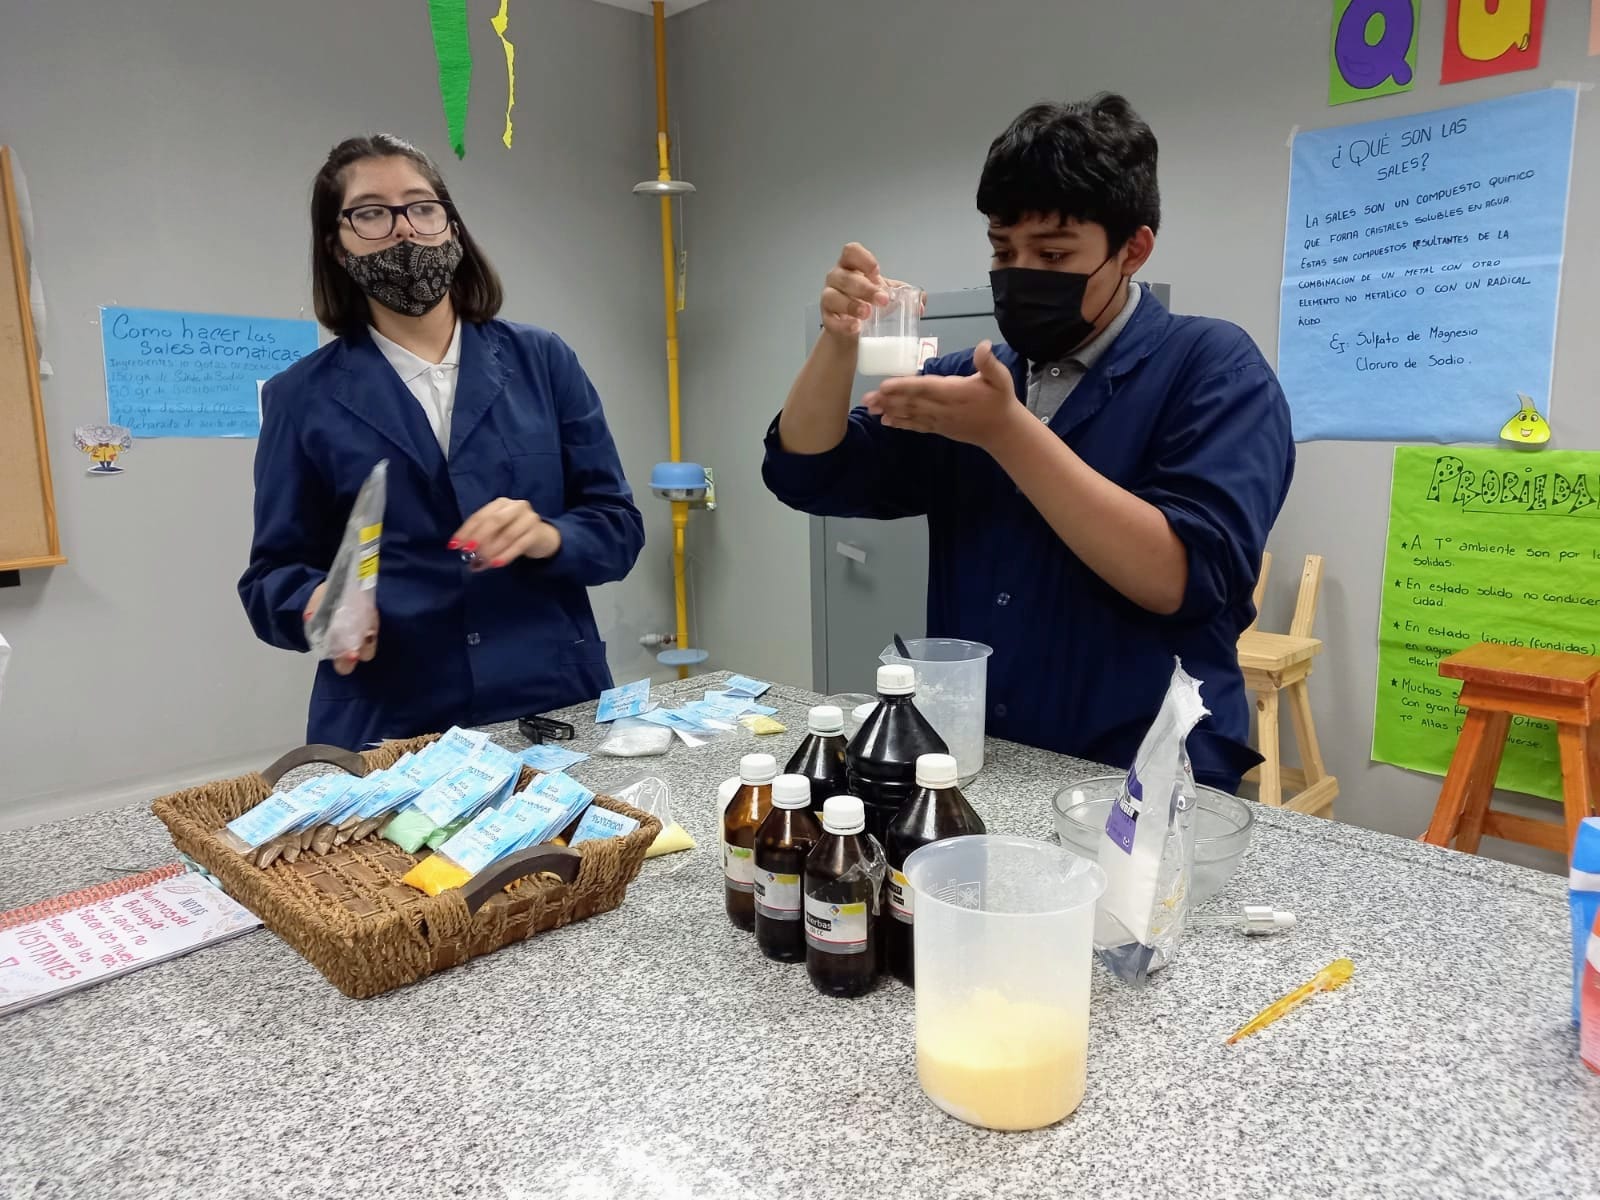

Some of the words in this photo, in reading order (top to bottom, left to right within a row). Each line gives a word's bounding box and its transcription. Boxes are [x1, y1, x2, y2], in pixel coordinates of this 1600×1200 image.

[1401, 126, 1432, 147] SON
[1441, 119, 1468, 138] LAS
[1377, 153, 1430, 181] SALES?
[1305, 214, 1319, 229] LA
[1325, 208, 1357, 225] SALES
[1364, 202, 1385, 215] SON
[1394, 198, 1409, 209] UN
[1416, 180, 1481, 206] COMPUESTO
[1489, 170, 1535, 188] QUIMICO
[1304, 238, 1320, 251] QUE
[1330, 230, 1359, 244] FORMA
[1365, 220, 1409, 238] CRISTALES
[1468, 203, 1483, 213] EN
[1332, 255, 1349, 265] SON
[1352, 242, 1407, 262] COMPUESTOS
[1478, 231, 1490, 241] DE
[1497, 230, 1510, 240] LA
[1361, 273, 1372, 282] DE
[1381, 271, 1396, 280] UN
[1404, 266, 1435, 277] METAL
[1441, 263, 1463, 272] CON
[1472, 259, 1501, 269] OTRO
[1299, 297, 1341, 308] ELEMENTO
[1345, 295, 1358, 304] NO
[1416, 286, 1425, 296] O
[1434, 282, 1458, 294] CON
[1465, 279, 1481, 290] UN
[113, 313, 173, 340] Como
[182, 317, 241, 342] hacer
[1355, 330, 1400, 350] Sulfato
[1407, 329, 1422, 343] de
[1429, 326, 1479, 344] Magnesio
[140, 340, 195, 356] Sales
[200, 341, 303, 362] aromaticas
[1355, 355, 1399, 372] Cloruro
[1404, 354, 1418, 370] de
[1411, 533, 1422, 551] A
[1459, 541, 1516, 557] ambiente
[1526, 547, 1551, 559] son
[1559, 550, 1581, 563] por
[1406, 577, 1421, 590] En
[1429, 582, 1469, 596] estado
[1477, 586, 1513, 599] solido
[1523, 591, 1539, 601] no
[1405, 620, 1420, 633] En
[1428, 625, 1471, 640] estado
[1405, 642, 1419, 650] en
[1425, 645, 1452, 659] agua
[1402, 677, 1443, 697] Muchas
[1425, 702, 1450, 714] gran
[1513, 715, 1550, 731] Otras
[178, 897, 209, 917] NOTAS
[45, 918, 65, 934] Son
[78, 945, 94, 963] los
[98, 927, 119, 948] las
[131, 933, 148, 947] no
[15, 926, 82, 981] VISITANTES
